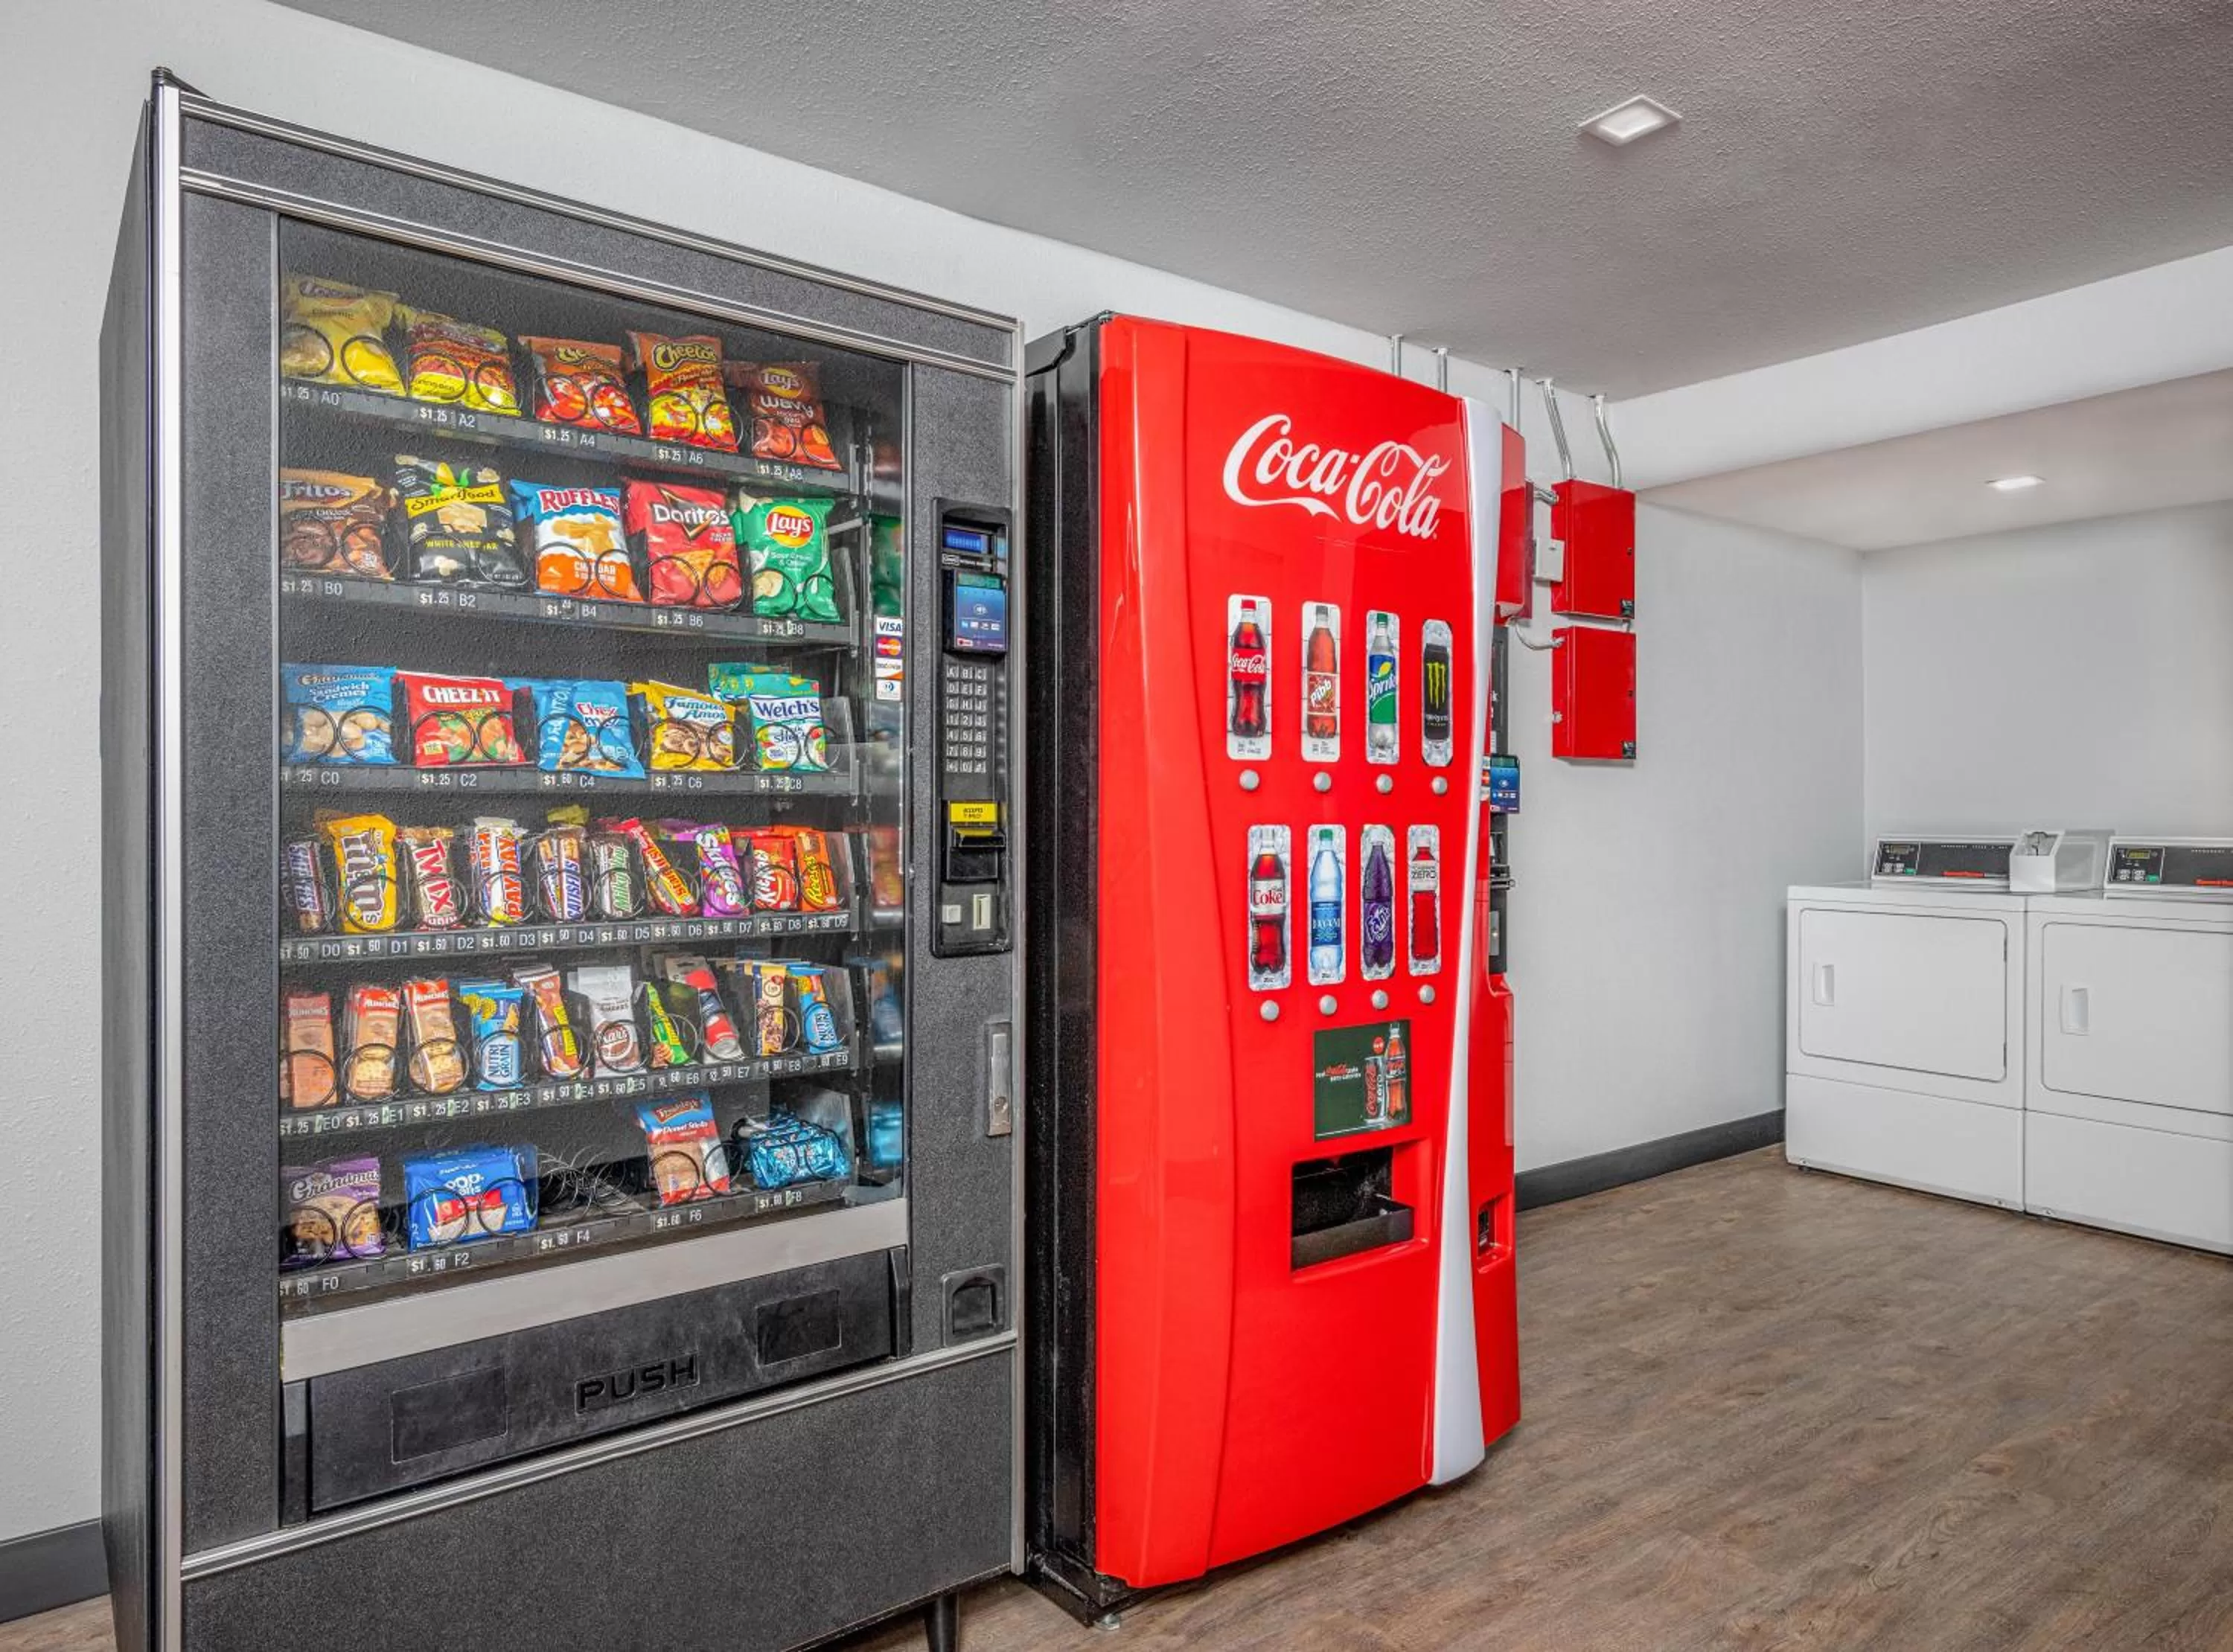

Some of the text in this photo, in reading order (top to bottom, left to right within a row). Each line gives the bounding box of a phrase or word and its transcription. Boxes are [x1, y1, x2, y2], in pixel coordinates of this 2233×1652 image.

[654, 344, 718, 369] Cheetos
[321, 391, 339, 405] A0
[419, 408, 476, 429] $1.25 A2
[544, 429, 595, 446] $1.25 A4
[658, 448, 703, 464] $1.25 A6
[1221, 413, 1451, 540] Coca-Cola
[411, 488, 496, 510] Smartfood
[538, 487, 620, 515] RUFFLES
[652, 502, 731, 525] Doritos
[769, 513, 811, 538] Lay's
[281, 579, 343, 595] $1.25 B0
[419, 592, 476, 608] $1.25 B2
[581, 605, 596, 617] B4
[657, 613, 683, 625] $1.25
[878, 621, 902, 633] VISA
[1230, 653, 1265, 674] Coca-Cola
[1309, 679, 1332, 708] Pibb
[755, 699, 820, 718] Welch's
[320, 772, 339, 785] C0
[421, 773, 477, 787] $1.25 C2
[579, 775, 595, 788] C4
[655, 775, 703, 789] $1.25 C6
[412, 839, 455, 914] TWIX
[1411, 871, 1437, 880] ZERO
[1253, 889, 1283, 906] Coke
[738, 921, 752, 934] D7
[788, 917, 802, 929] D8
[578, 930, 593, 943] D4
[635, 928, 649, 940] D5
[688, 924, 702, 937] D6
[391, 940, 408, 953] D1
[457, 937, 474, 950] D2
[482, 934, 535, 948] $1.60 D3
[322, 944, 340, 957] D0
[488, 1045, 501, 1078] NUTRI
[500, 1043, 514, 1078] GRAIN
[788, 1060, 802, 1072] E8
[836, 1054, 848, 1066] E9
[686, 1072, 699, 1084] E6
[738, 1066, 750, 1078] E7
[581, 1085, 594, 1097] E4
[633, 1078, 645, 1091] E5
[413, 1100, 469, 1117] $1.25 E2
[477, 1096, 508, 1110] $1.25
[346, 1109, 403, 1128] $1.25 E1
[280, 1116, 340, 1136] $1.25 E0
[576, 1230, 590, 1243] F4
[454, 1252, 469, 1266] F2
[322, 1276, 339, 1291] F0
[578, 1353, 696, 1409] PUSH
